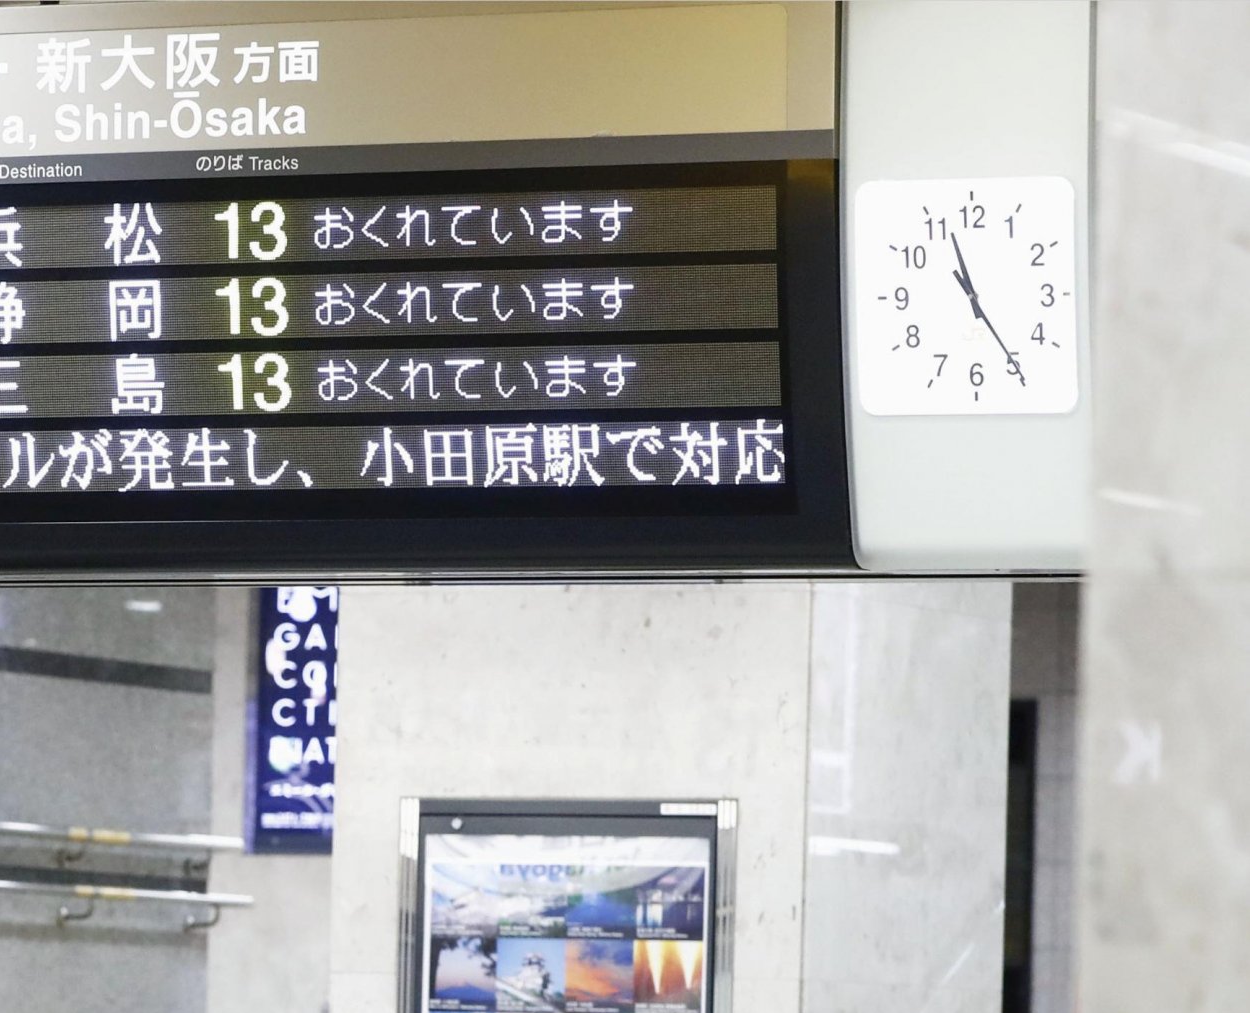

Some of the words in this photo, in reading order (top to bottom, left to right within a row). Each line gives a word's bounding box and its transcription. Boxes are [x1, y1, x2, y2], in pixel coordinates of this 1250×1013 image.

[54, 91, 307, 144] Shin-Ōsaka
[0, 163, 82, 179] Destination
[196, 155, 243, 171] のりば
[249, 156, 298, 170] Tracks
[960, 205, 985, 228] 12
[1005, 216, 1013, 238] 1
[214, 202, 287, 260] 13
[314, 200, 633, 249] おくれています
[925, 218, 945, 240] 11
[902, 246, 926, 269] 10
[1031, 244, 1044, 266] 2
[215, 278, 289, 336] 13
[315, 277, 634, 325] おくれています
[895, 287, 909, 310] 9
[1041, 284, 1054, 307] 3
[906, 325, 920, 348] 8
[1031, 323, 1045, 345] 4
[934, 354, 948, 376] 7
[970, 363, 983, 386] 6
[1005, 352, 1021, 376] 5
[218, 353, 292, 411] 13
[318, 354, 636, 400] おくれています
